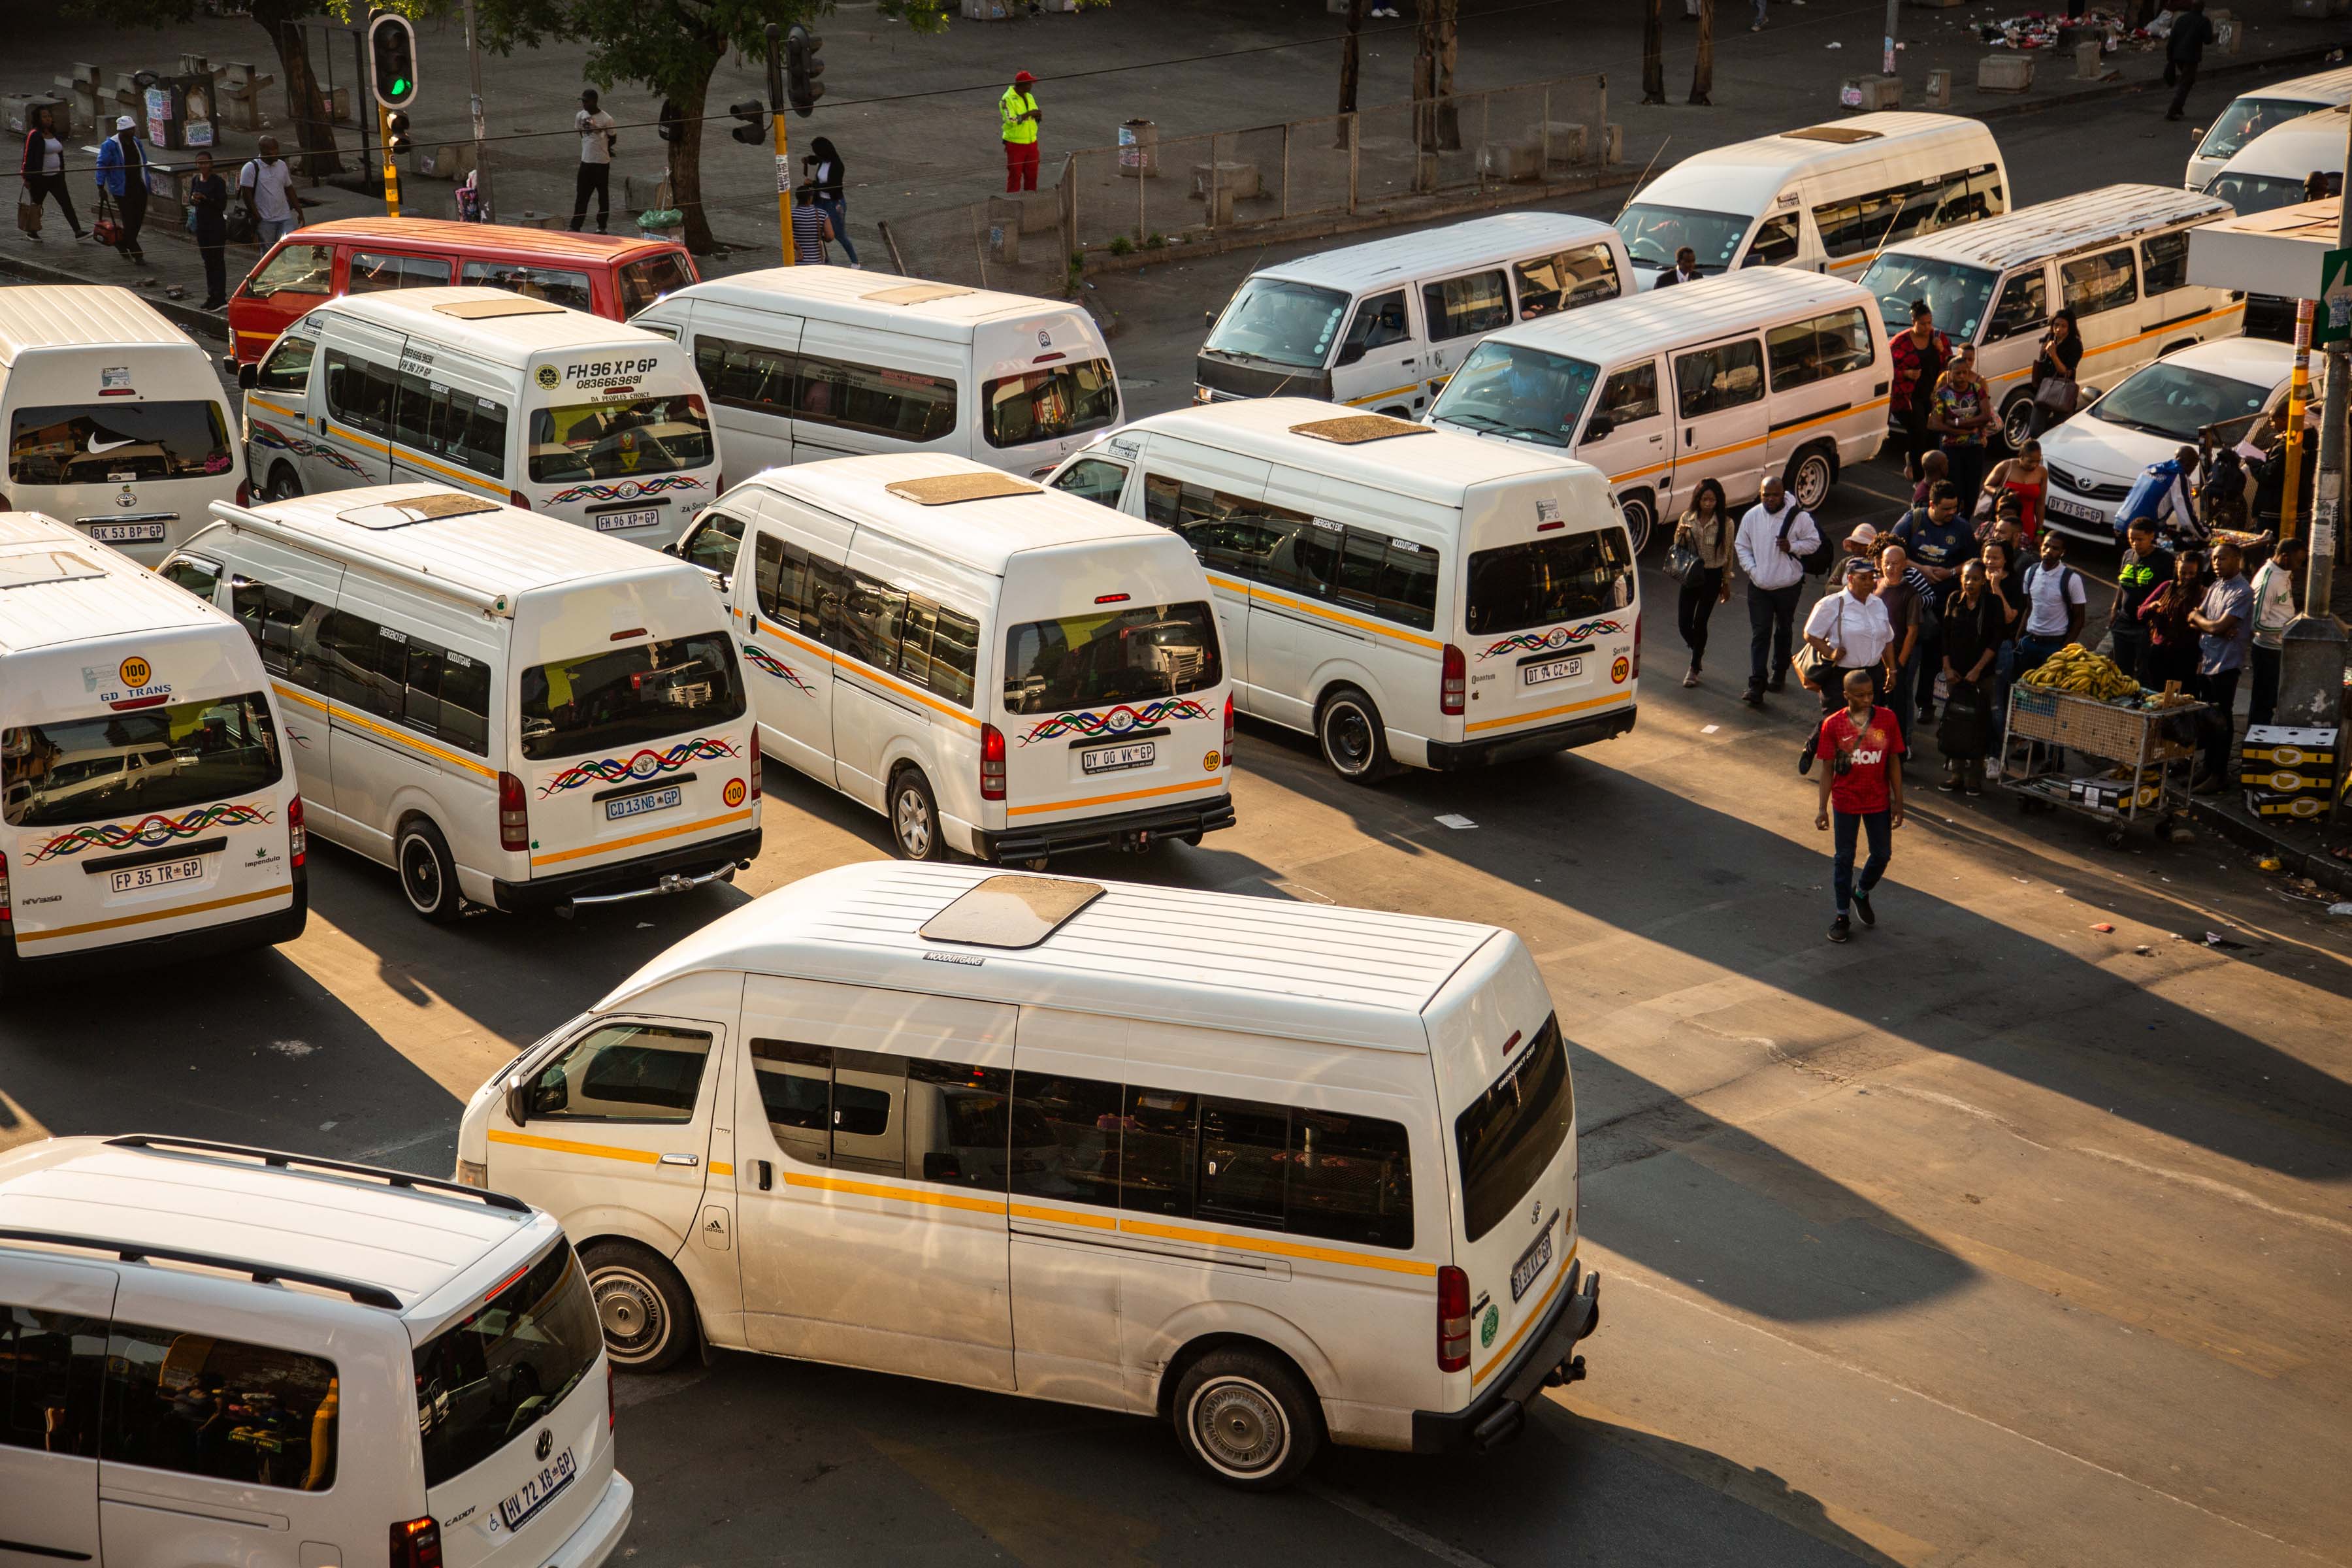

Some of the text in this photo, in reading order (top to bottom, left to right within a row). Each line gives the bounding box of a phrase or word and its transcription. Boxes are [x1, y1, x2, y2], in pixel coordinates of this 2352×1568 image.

[566, 364, 588, 380] FH
[589, 361, 612, 377] 96
[637, 358, 658, 373] GP
[576, 374, 642, 389] 0836669691
[630, 391, 650, 400] CHOICE
[2050, 498, 2100, 521] DY 73 SG GP
[600, 512, 655, 529] FH 96 XP GP
[1312, 517, 1344, 532] EMERGENCY EXIT
[94, 525, 162, 540] BK 53 BP GP
[1391, 538, 1420, 553] NOODUITGANG
[379, 626, 408, 645] EMERGENCY EXIT
[446, 651, 471, 668] NOODUITGANG
[125, 664, 146, 678] 100
[1528, 669, 1538, 682] DT
[1553, 664, 1563, 676] CZ
[1569, 661, 1580, 674] GP
[1614, 663, 1627, 677] 100
[1471, 674, 1495, 685] Quantum
[100, 684, 172, 702] GD TRANS
[1085, 753, 1098, 767] DY
[1121, 748, 1134, 762] VK
[1140, 745, 1152, 759] GP
[1205, 754, 1218, 765] 100
[1850, 749, 1882, 765] AON
[727, 787, 742, 801] 100
[610, 791, 678, 817] CD 13 NB GP
[116, 861, 199, 889] FP 35 TR GP
[927, 953, 983, 965] NOODUITGANG
[1497, 1043, 1535, 1091] EMERGENCY EXIT
[1541, 1238, 1550, 1260] GP
[506, 1494, 522, 1520] HV
[522, 1480, 538, 1507] 72
[538, 1468, 553, 1494] XB
[557, 1452, 570, 1477] GP
[444, 1505, 476, 1527] CADDY
